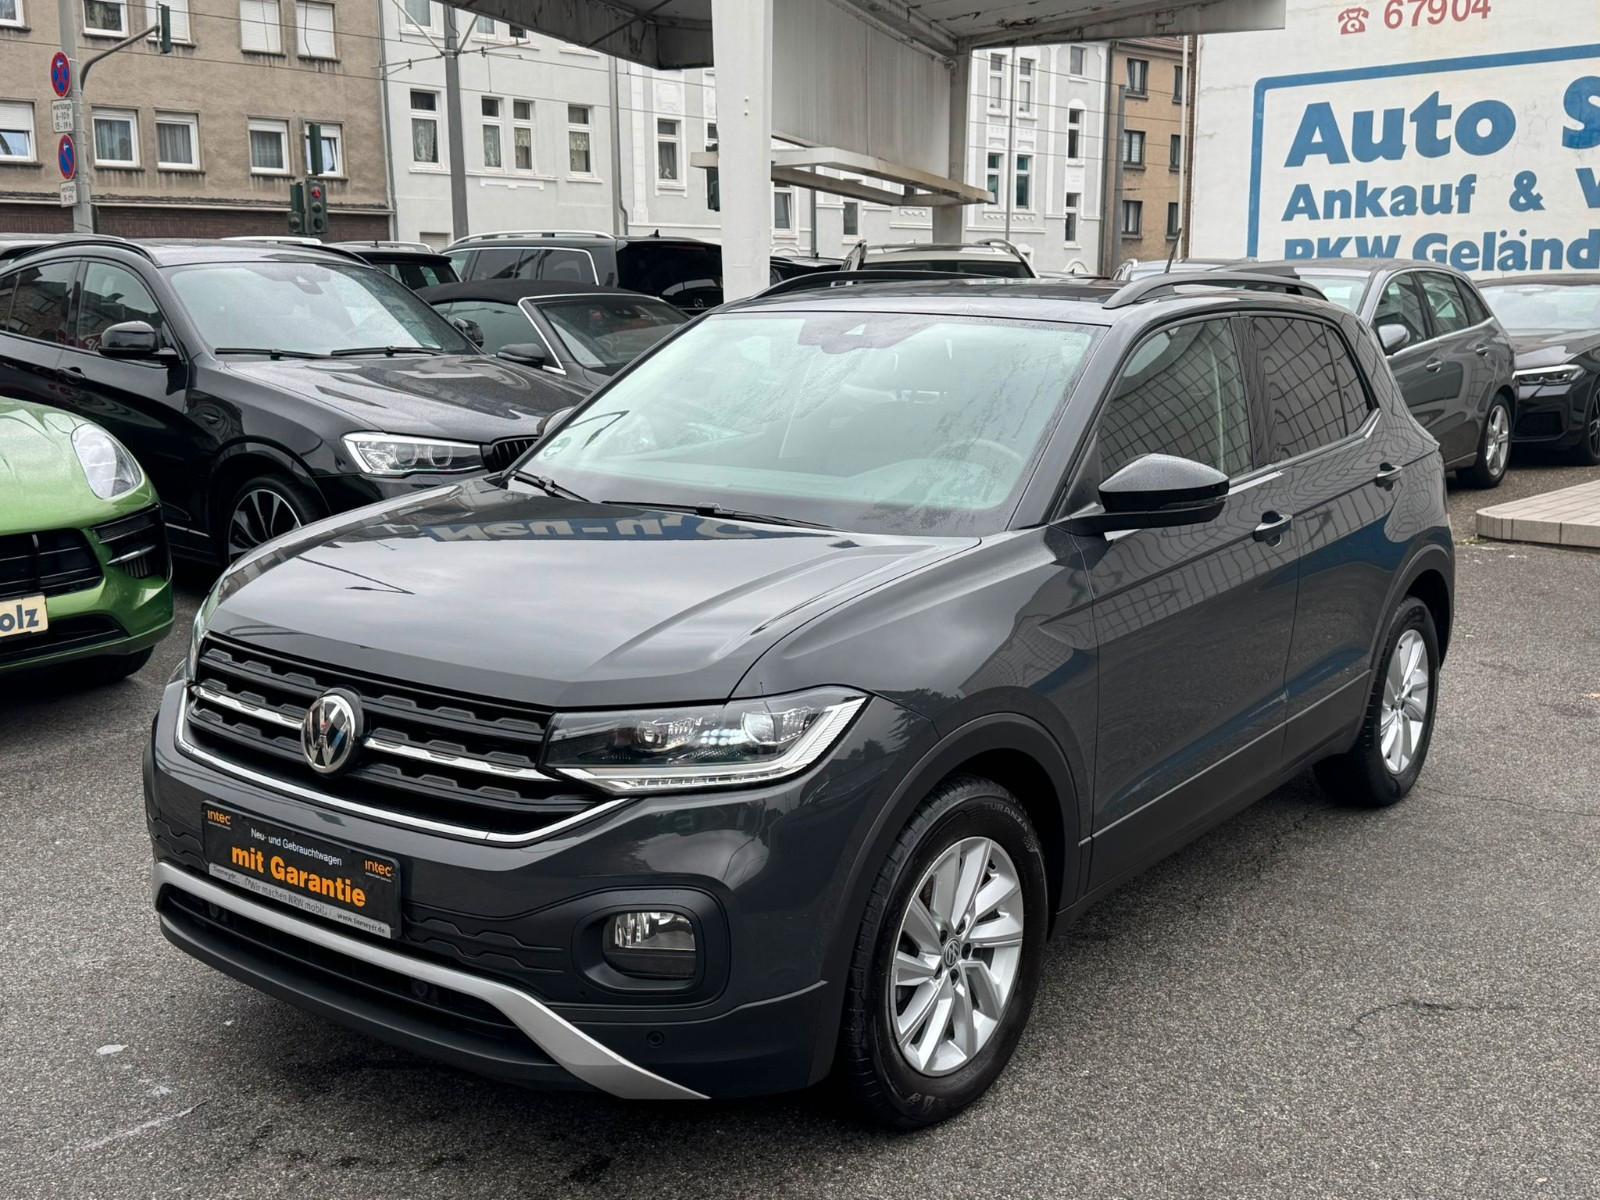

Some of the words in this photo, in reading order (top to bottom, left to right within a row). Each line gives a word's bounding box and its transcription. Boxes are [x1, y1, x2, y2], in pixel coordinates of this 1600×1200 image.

[1384, 0, 1491, 29] 67904
[1284, 90, 1516, 167] Auto
[1281, 174, 1477, 221] Ankauf
[1509, 170, 1545, 212] &
[1412, 229, 1600, 271] Geländ
[250, 827, 267, 841] Neu-
[268, 836, 281, 847] und
[282, 838, 342, 866] Gebrauchtwagen
[231, 846, 265, 874] mit
[270, 855, 366, 907] Garantie
